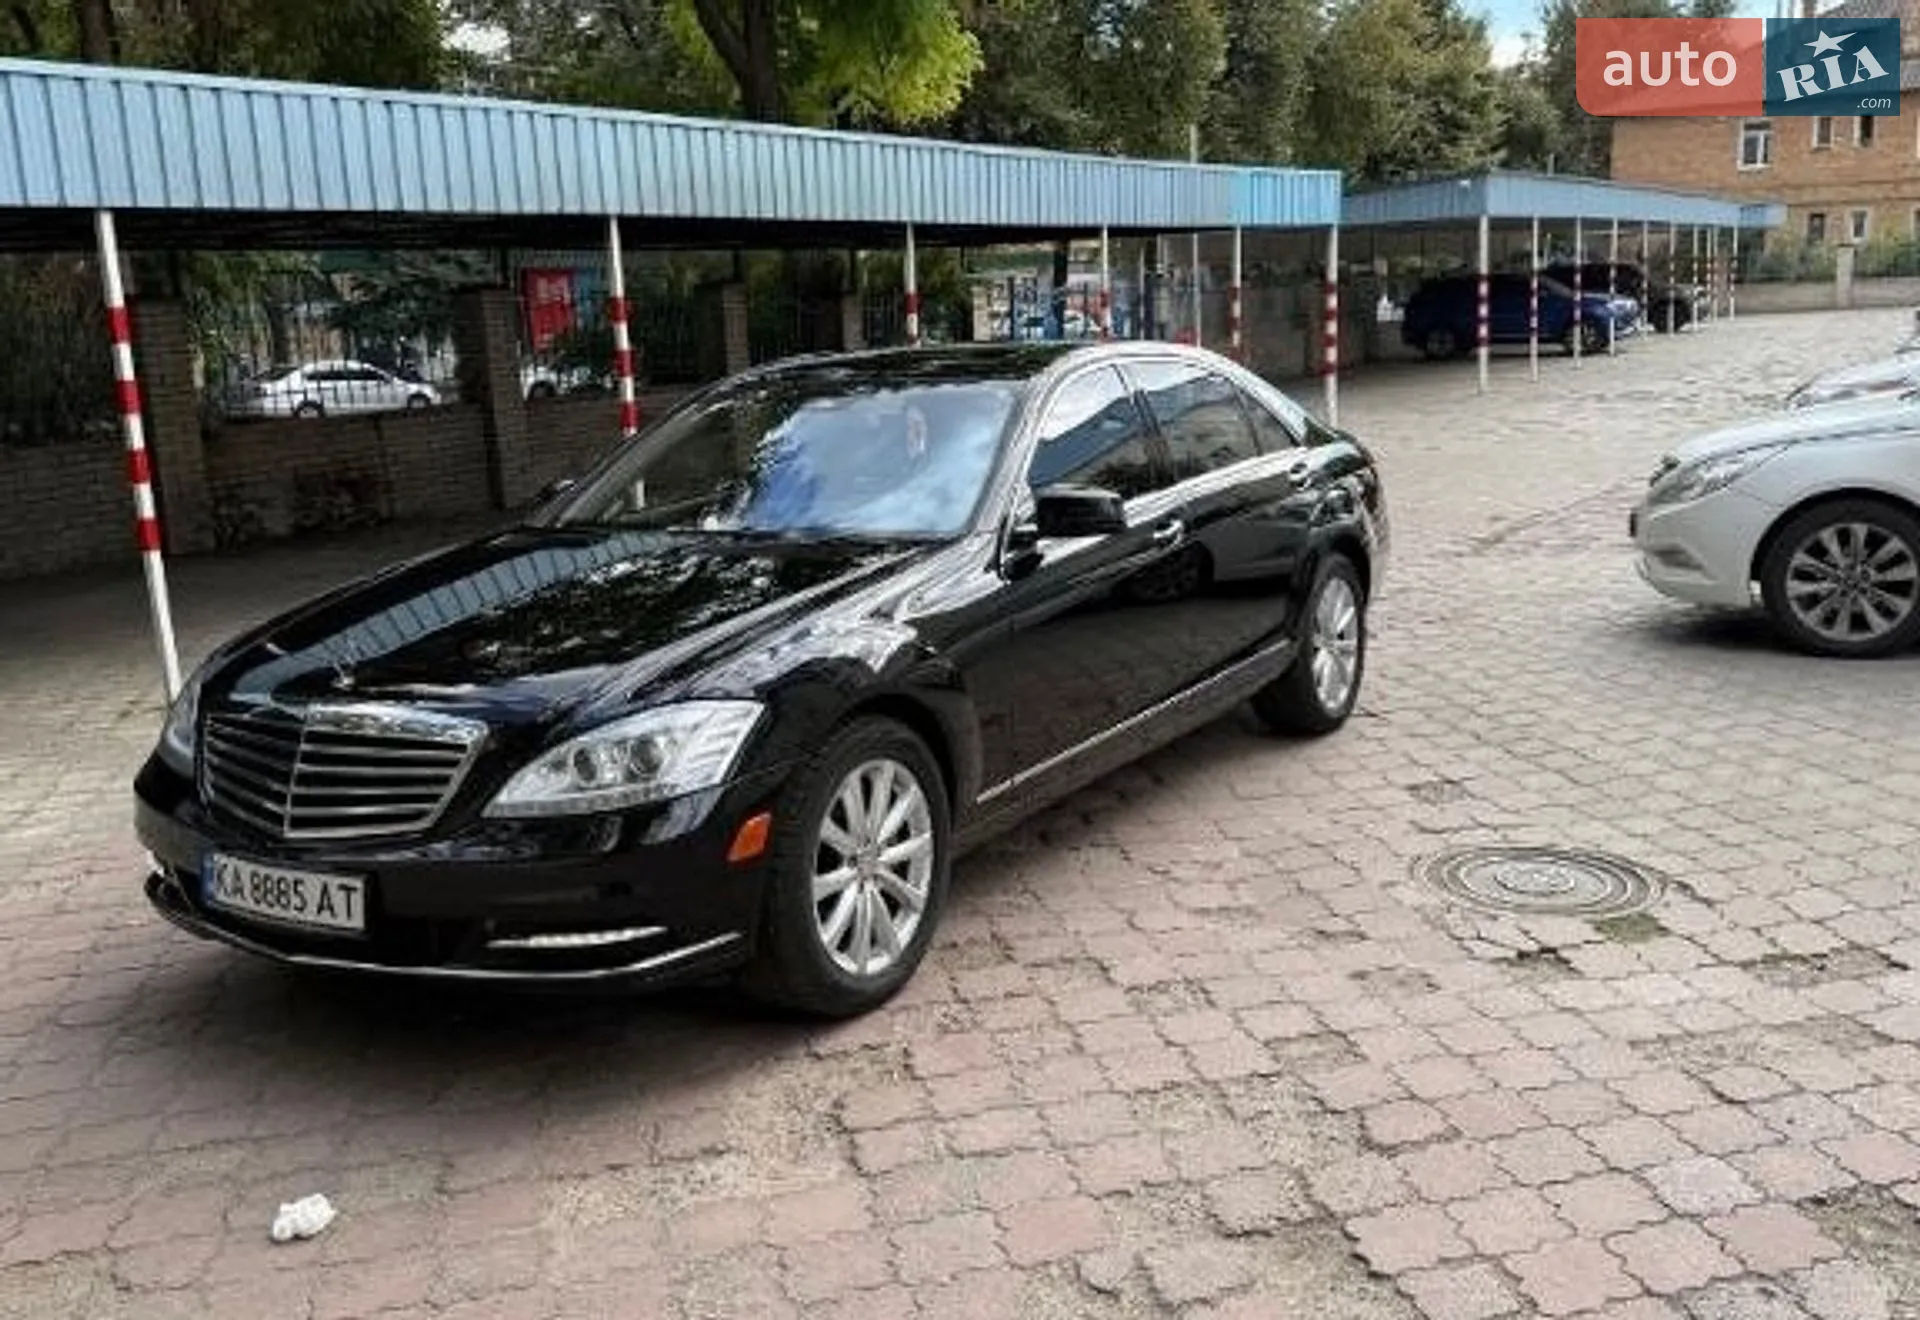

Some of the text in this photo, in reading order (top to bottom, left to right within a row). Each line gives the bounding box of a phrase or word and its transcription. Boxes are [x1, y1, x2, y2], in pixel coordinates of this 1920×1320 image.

[215, 862, 358, 921] KA 8885 AT
